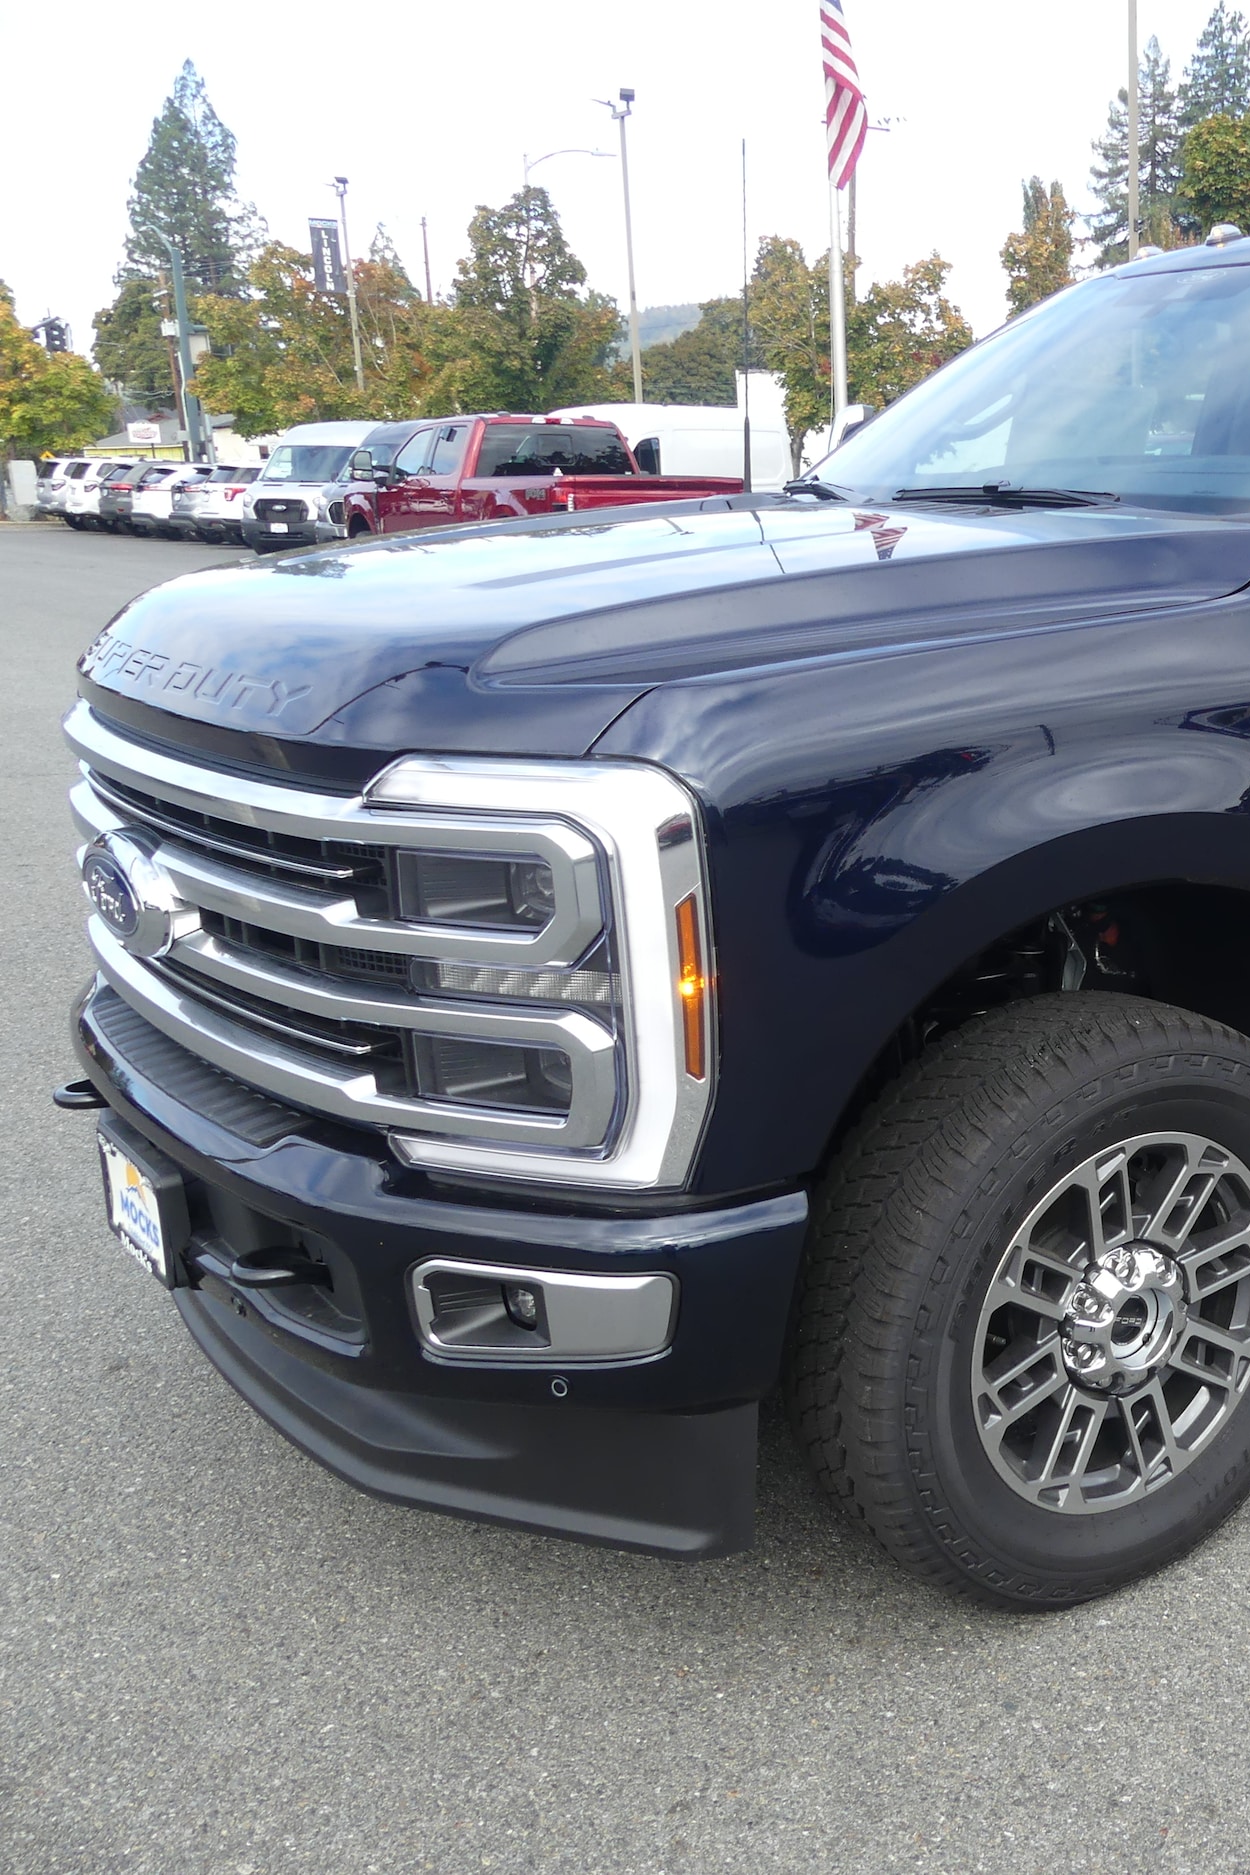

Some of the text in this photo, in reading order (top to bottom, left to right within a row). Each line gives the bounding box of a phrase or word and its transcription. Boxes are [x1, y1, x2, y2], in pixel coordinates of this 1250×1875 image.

[321, 229, 335, 291] LINCOLN
[164, 661, 313, 717] DUTY
[120, 1190, 160, 1247] MOCKS
